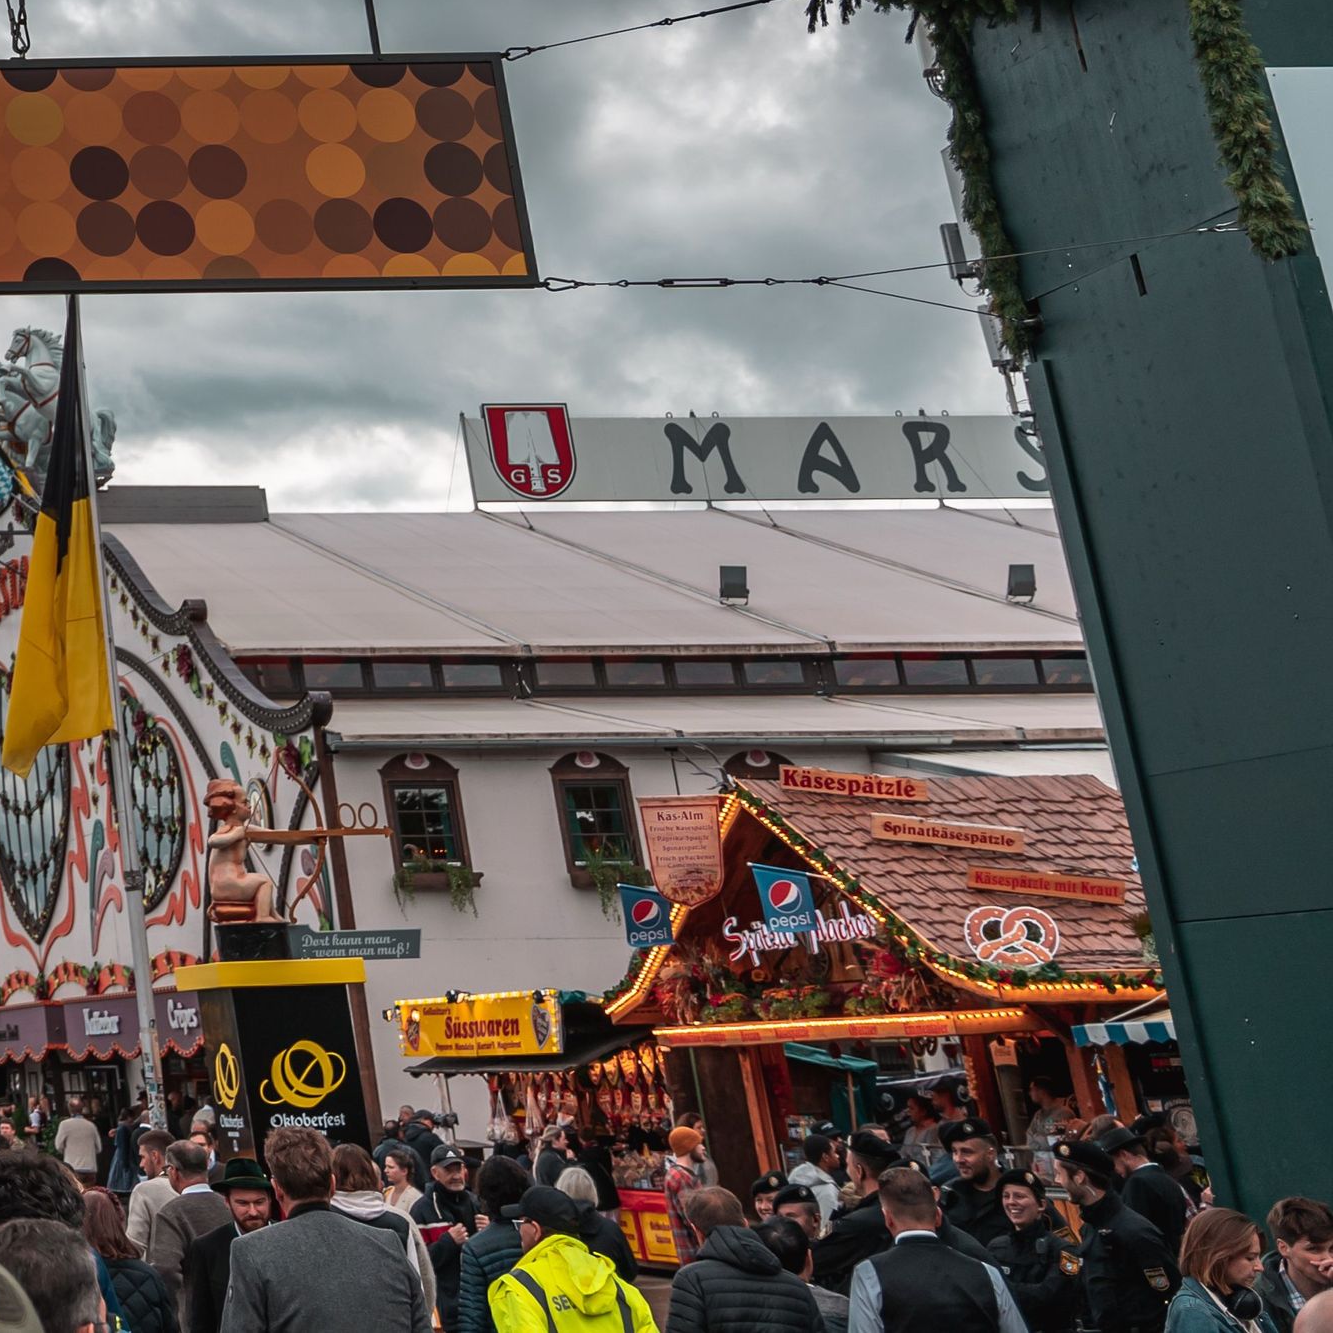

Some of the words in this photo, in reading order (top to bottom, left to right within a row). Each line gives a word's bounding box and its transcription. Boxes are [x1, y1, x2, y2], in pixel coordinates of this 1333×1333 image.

[510, 469, 525, 484] G
[547, 469, 562, 484] S
[782, 768, 916, 798] Käsespätzle
[883, 820, 1015, 848] Spinatkäsespätzle
[974, 870, 1051, 894] Käsespätzle
[1054, 879, 1077, 894] mit
[1081, 881, 1119, 898] Kraut
[769, 911, 812, 930] pepsi
[301, 934, 330, 947] Dort
[332, 933, 362, 946] kann
[630, 927, 668, 944] pepsi
[312, 947, 346, 957] wenn
[348, 946, 375, 956] man
[377, 942, 410, 958] muß!
[445, 1016, 520, 1039] Süsswaren
[270, 1111, 346, 1128] Oktoberfest
